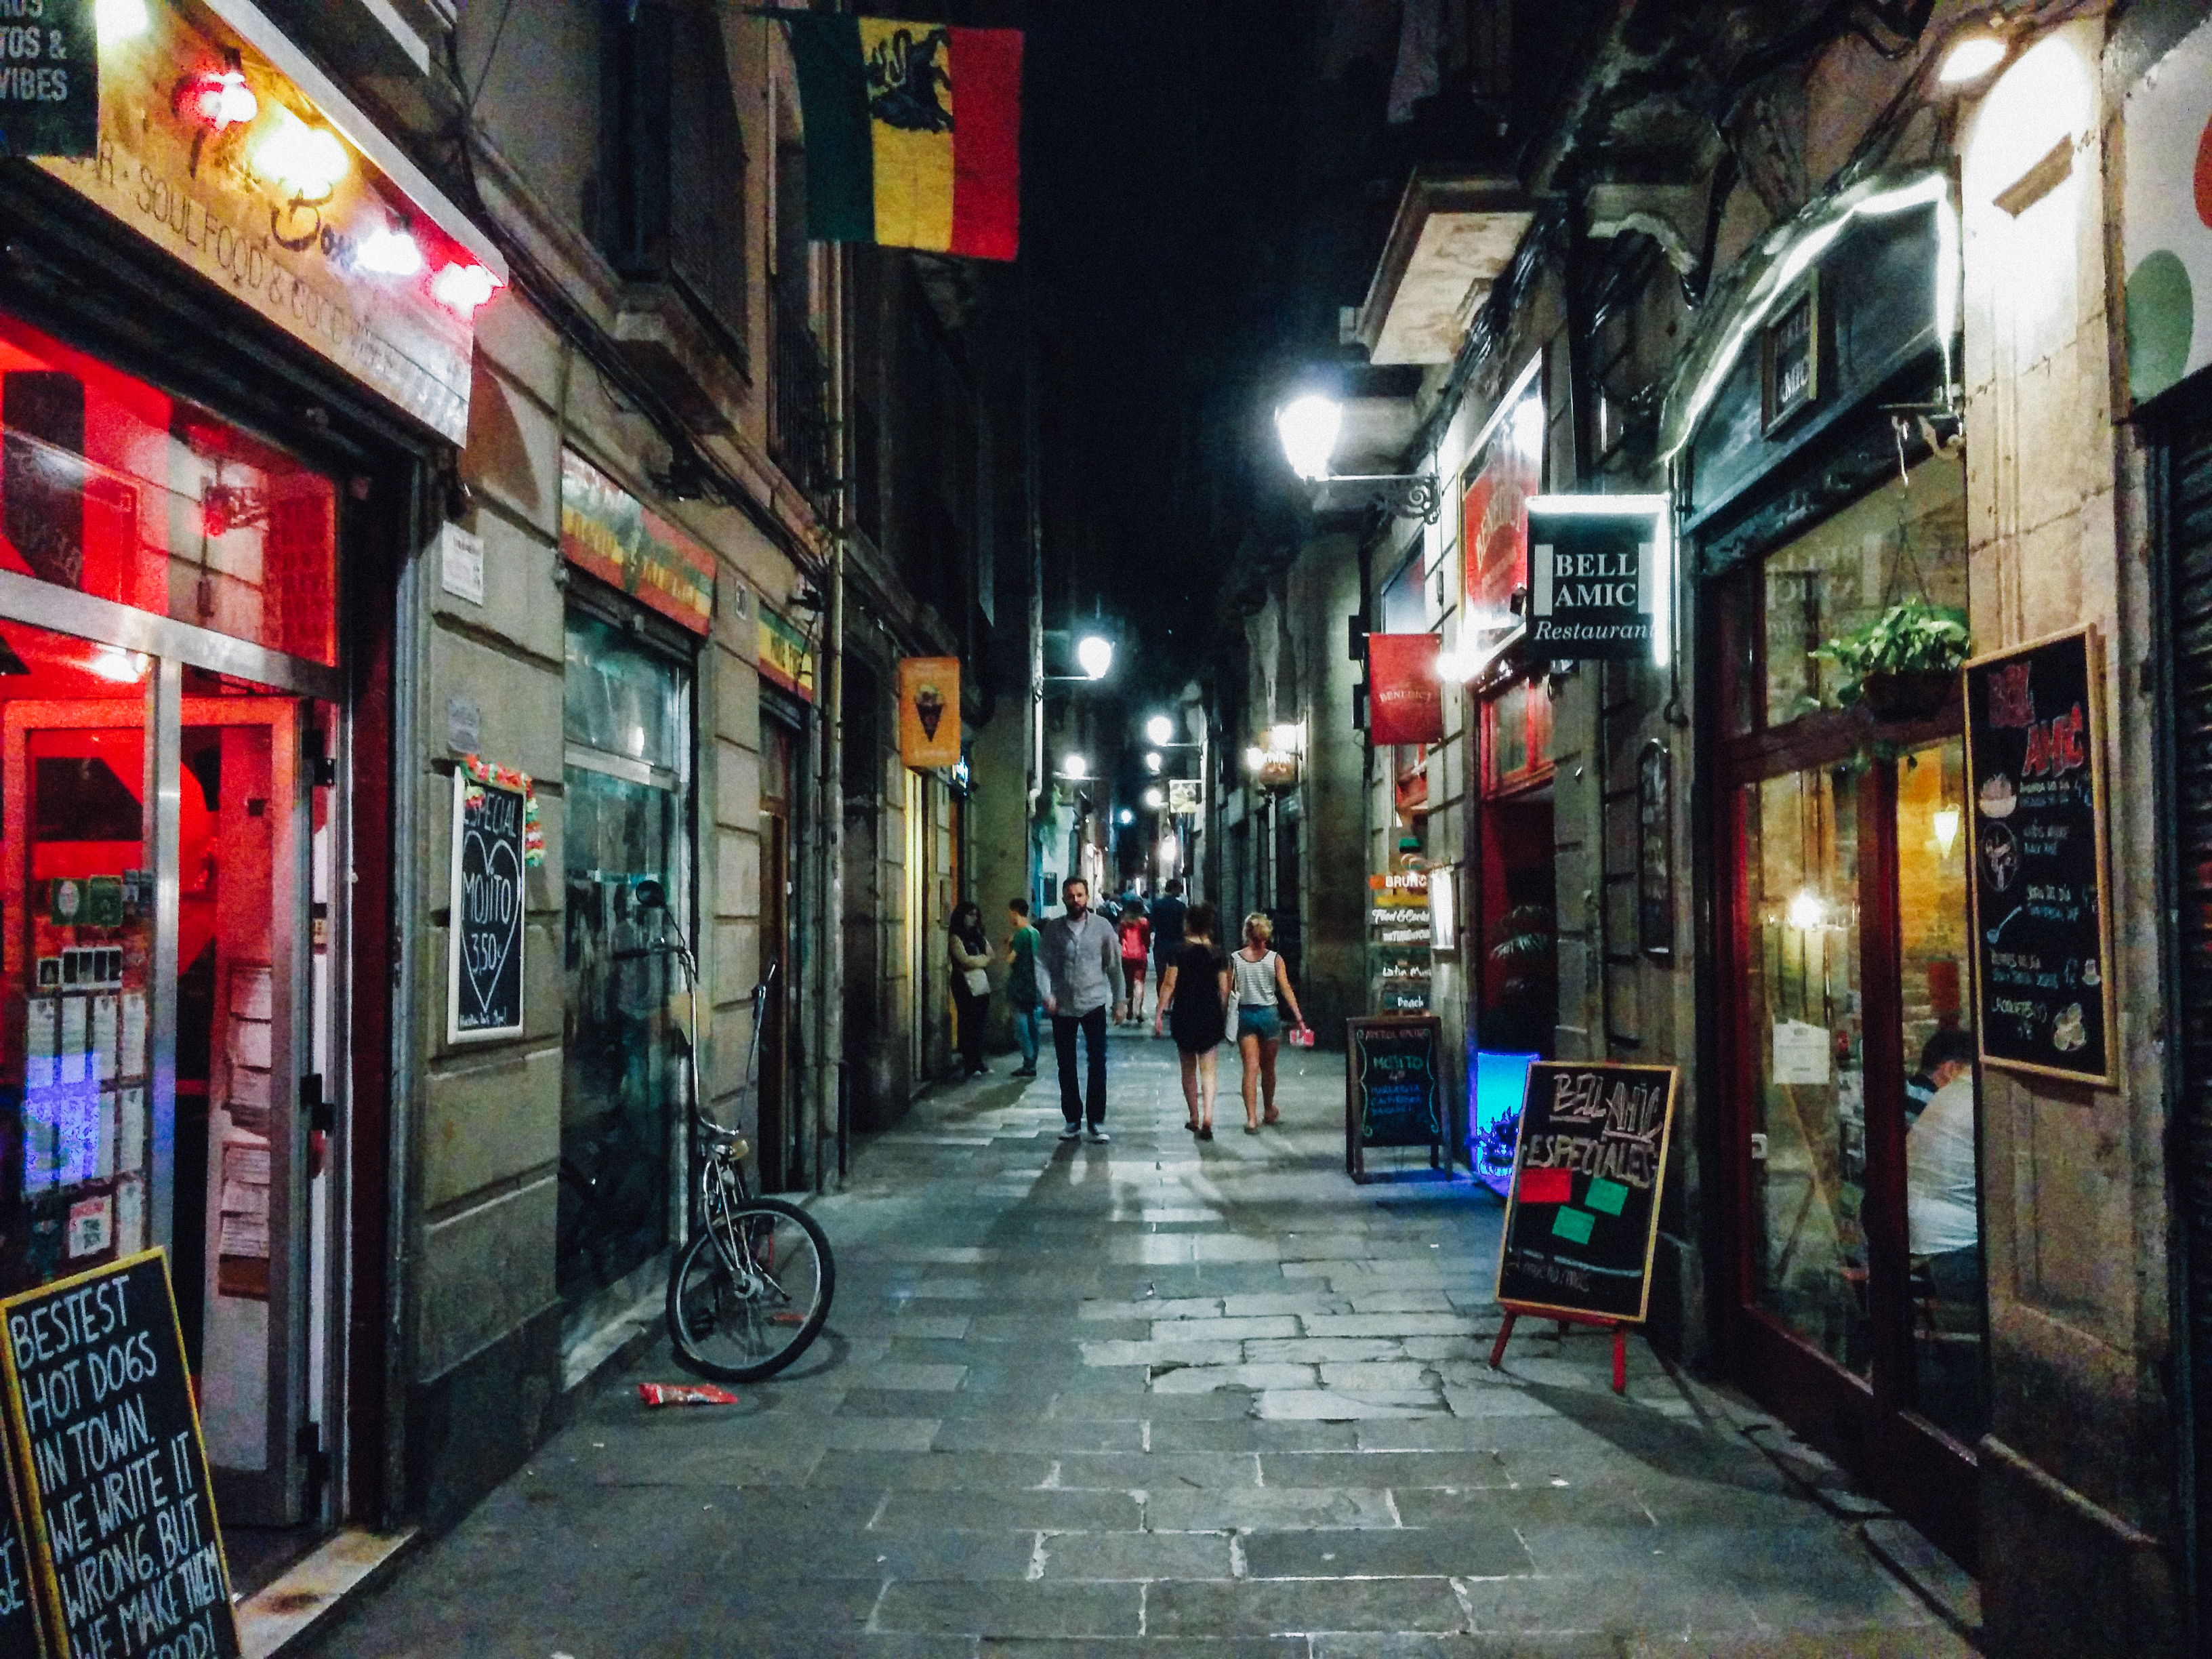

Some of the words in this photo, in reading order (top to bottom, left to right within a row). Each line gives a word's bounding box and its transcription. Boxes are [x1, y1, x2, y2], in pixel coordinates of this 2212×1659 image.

[49, 29, 67, 59] &
[1555, 553, 1637, 577] BELL
[1555, 583, 1637, 607] AMIC
[11, 1275, 130, 1370] BESTEST
[22, 1359, 80, 1433] HOT
[87, 1330, 157, 1403] DOGS
[35, 1431, 68, 1496] IN
[66, 1393, 156, 1479] TOWN.
[47, 1491, 93, 1565] WE
[90, 1448, 169, 1539] WRITE
[171, 1431, 193, 1494] IT
[157, 1493, 201, 1570] BUT
[118, 1571, 182, 1657] MAKE
[178, 1540, 226, 1615] THEM
